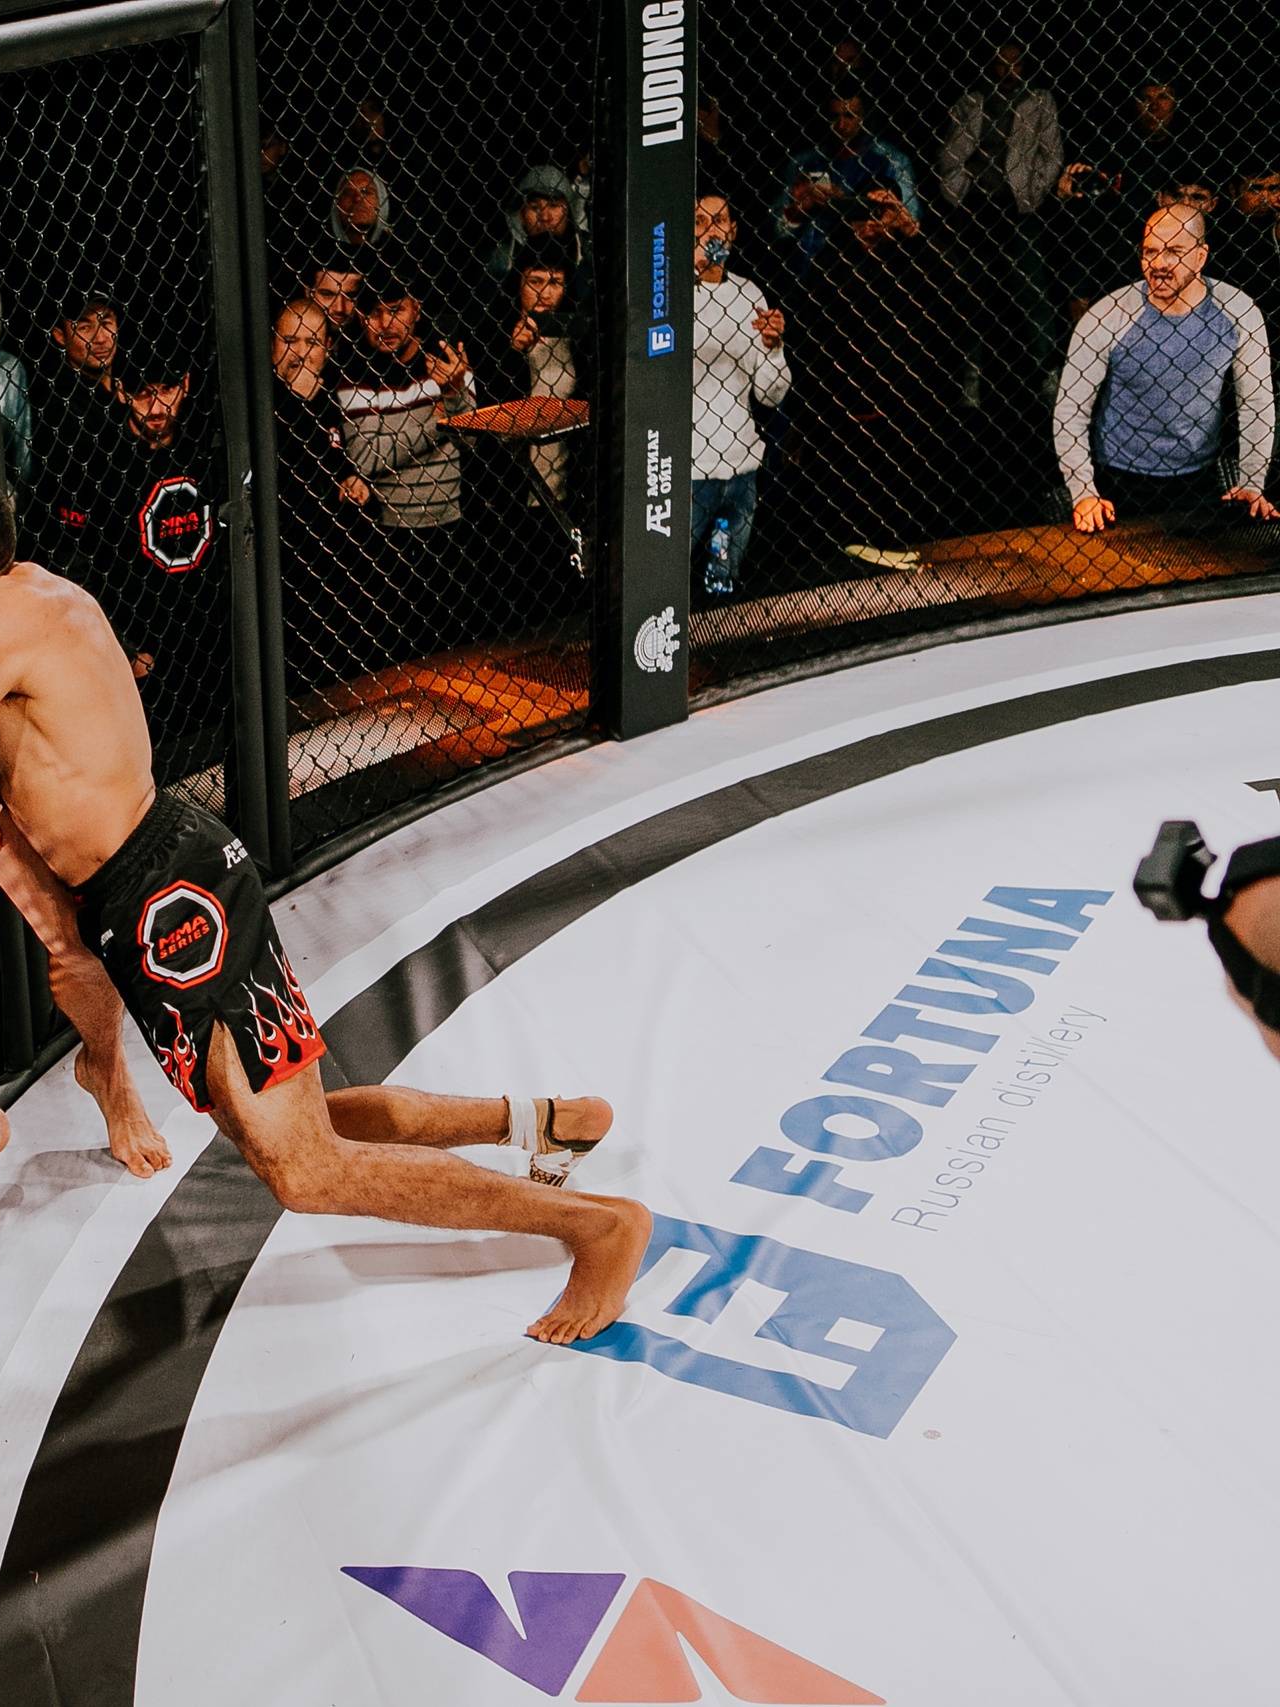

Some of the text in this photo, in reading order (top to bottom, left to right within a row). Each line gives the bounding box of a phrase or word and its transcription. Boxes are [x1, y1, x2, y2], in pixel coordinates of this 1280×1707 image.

[642, 0, 685, 147] LUDING
[652, 221, 665, 320] FORTUNA
[158, 915, 208, 950] MMA
[159, 924, 210, 960] SERIES
[729, 885, 1115, 1215] FORTUNA
[890, 1004, 1108, 1232] Russian distillery
